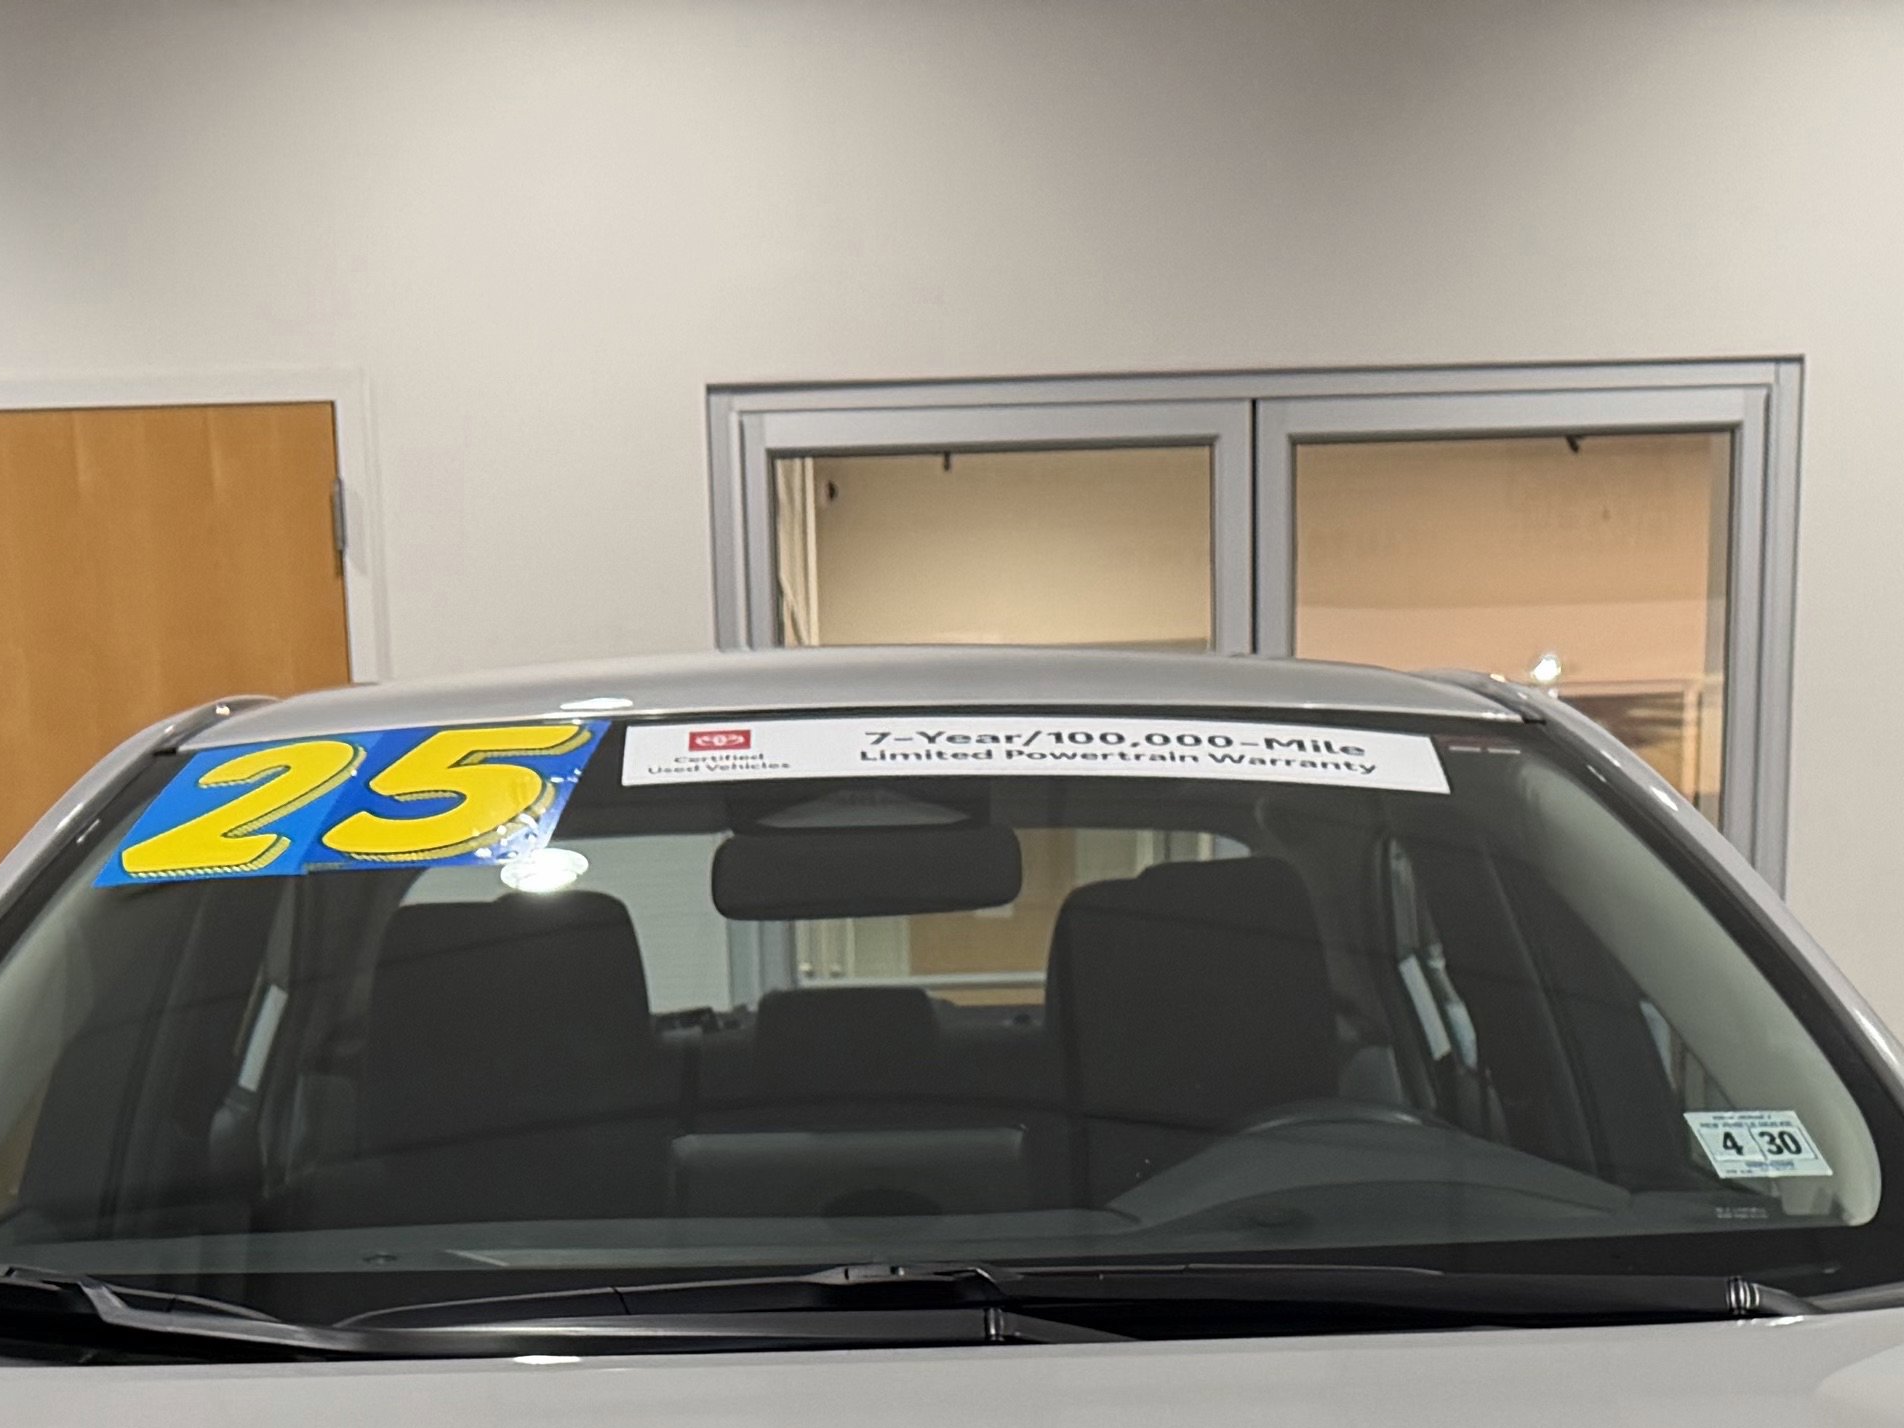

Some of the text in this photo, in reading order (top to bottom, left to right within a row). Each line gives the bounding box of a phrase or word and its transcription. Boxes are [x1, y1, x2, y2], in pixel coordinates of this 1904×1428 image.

[865, 730, 1365, 757] 7-Year/100,000-Mile
[648, 761, 791, 775] Used Vehicles
[673, 752, 765, 764] Certified
[860, 749, 1377, 775] Limited Powertrain Warranty
[120, 724, 592, 878] 25
[1722, 1130, 1803, 1156] 4 30
